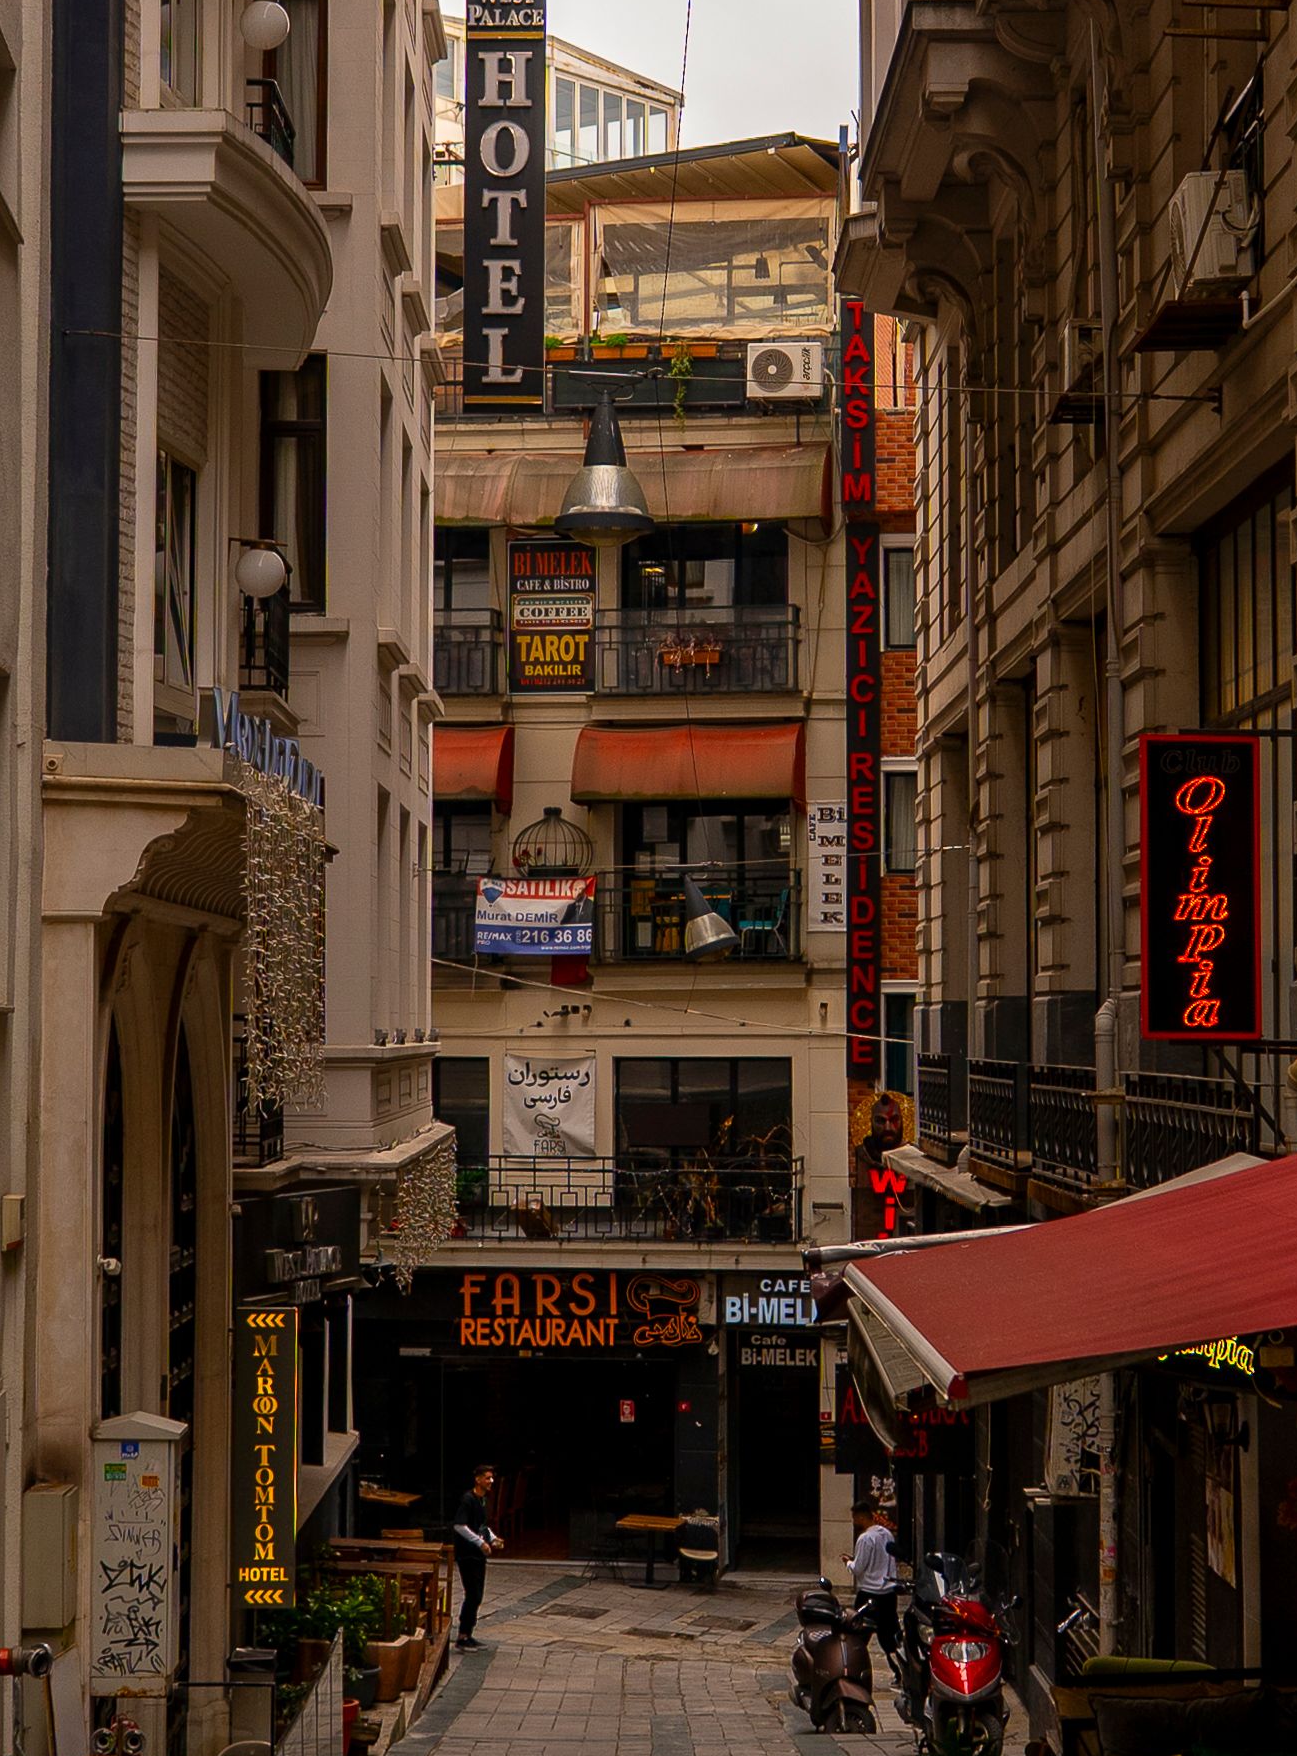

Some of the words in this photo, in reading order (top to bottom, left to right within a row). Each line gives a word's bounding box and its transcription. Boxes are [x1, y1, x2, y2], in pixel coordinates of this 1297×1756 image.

[468, 5, 545, 27] PALACE
[478, 50, 532, 385] HOTEL
[534, 550, 592, 576] MELEK
[516, 579, 542, 591] CAFE
[543, 579, 553, 591] &
[519, 607, 588, 618] COFFEE
[516, 634, 590, 662] TAROT
[849, 536, 875, 738] YAZICI
[525, 664, 583, 677] BAKILIR
[1160, 749, 1242, 774] Club
[506, 878, 572, 897] SATILIK
[818, 836, 845, 924] MELEK
[1174, 775, 1230, 1028] Olimpia
[477, 910, 512, 922] Murat
[477, 931, 512, 941] RE/MAX
[522, 929, 550, 943] 216
[554, 929, 573, 943] 36
[508, 1061, 591, 1087] رستوران
[459, 1272, 618, 1317] FARSI
[760, 1279, 812, 1294] CAFE
[460, 1318, 620, 1347] RESTAURANT
[750, 1334, 788, 1346] Cafe
[252, 1334, 279, 1434] MAROON
[254, 1444, 276, 1561] TOMTOM
[239, 1566, 289, 1583] HOTEL
